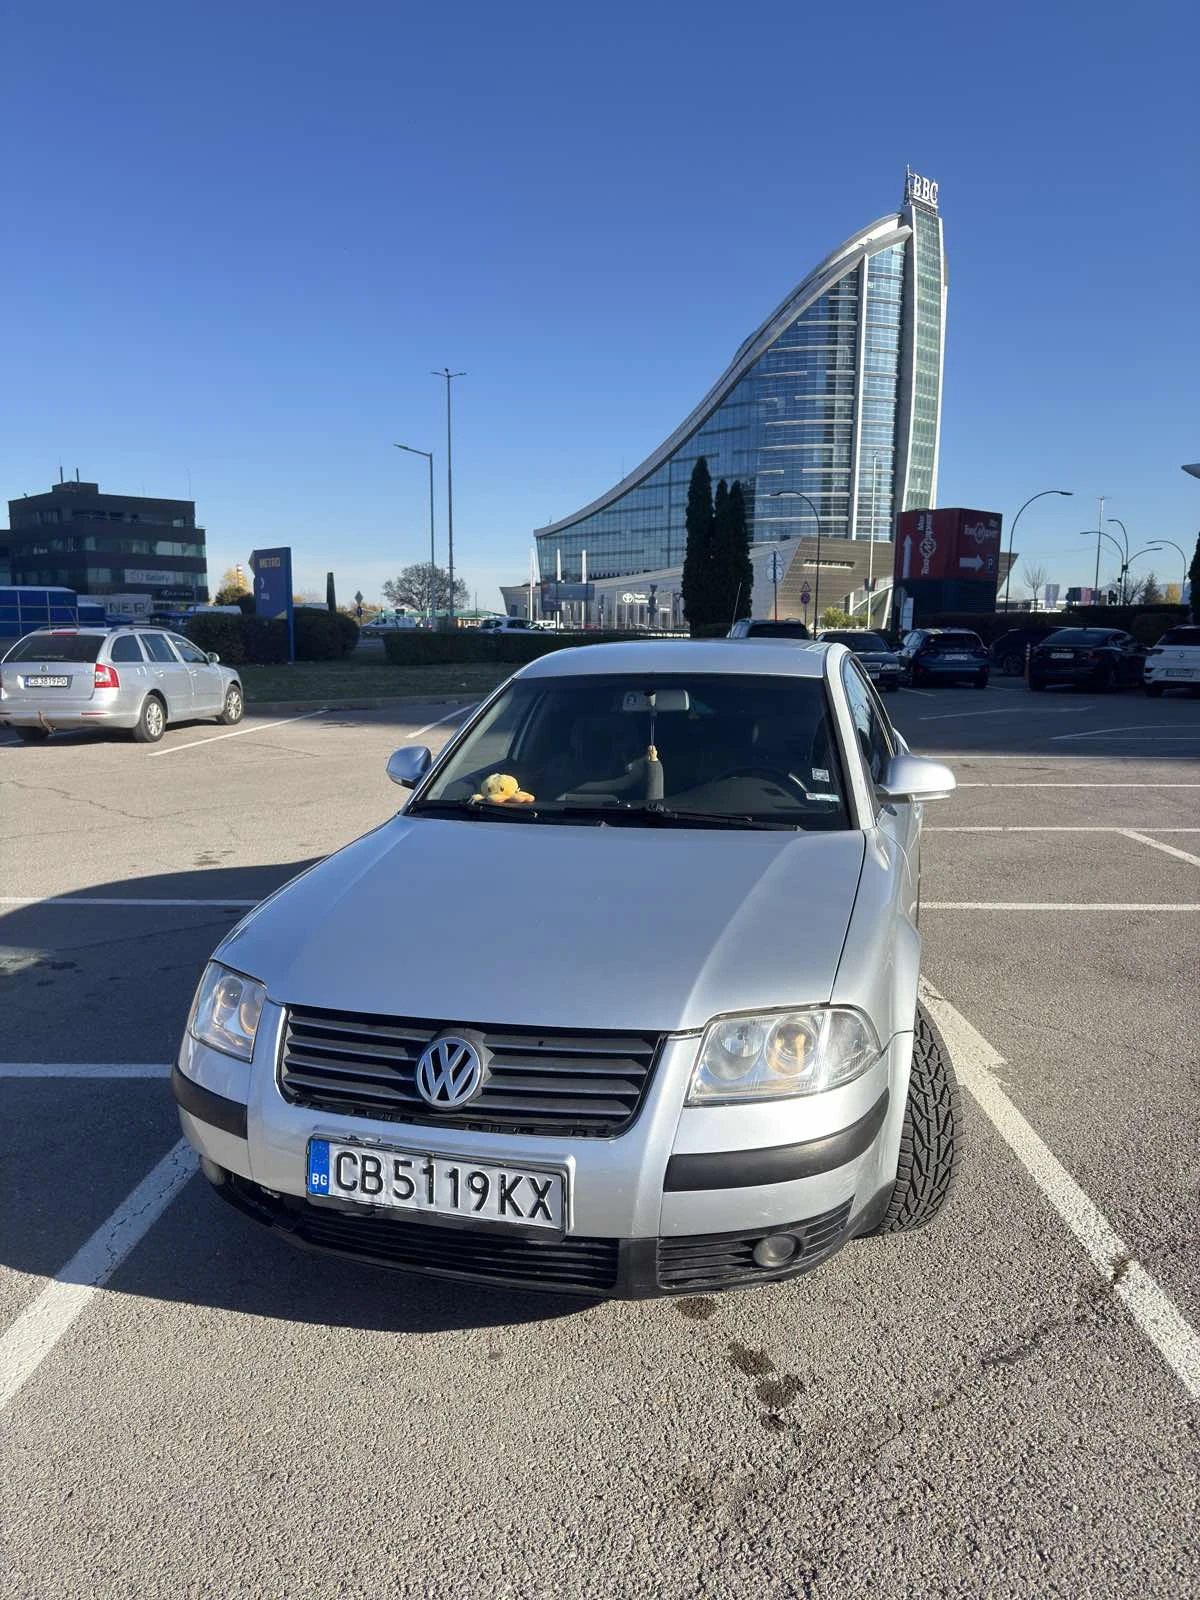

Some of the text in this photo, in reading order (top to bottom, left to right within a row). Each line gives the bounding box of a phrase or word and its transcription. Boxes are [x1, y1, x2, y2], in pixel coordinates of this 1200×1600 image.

[913, 173, 939, 205] BBC
[258, 557, 281, 569] METRO
[311, 1172, 328, 1187] BG
[335, 1150, 553, 1221] CB5119KX
